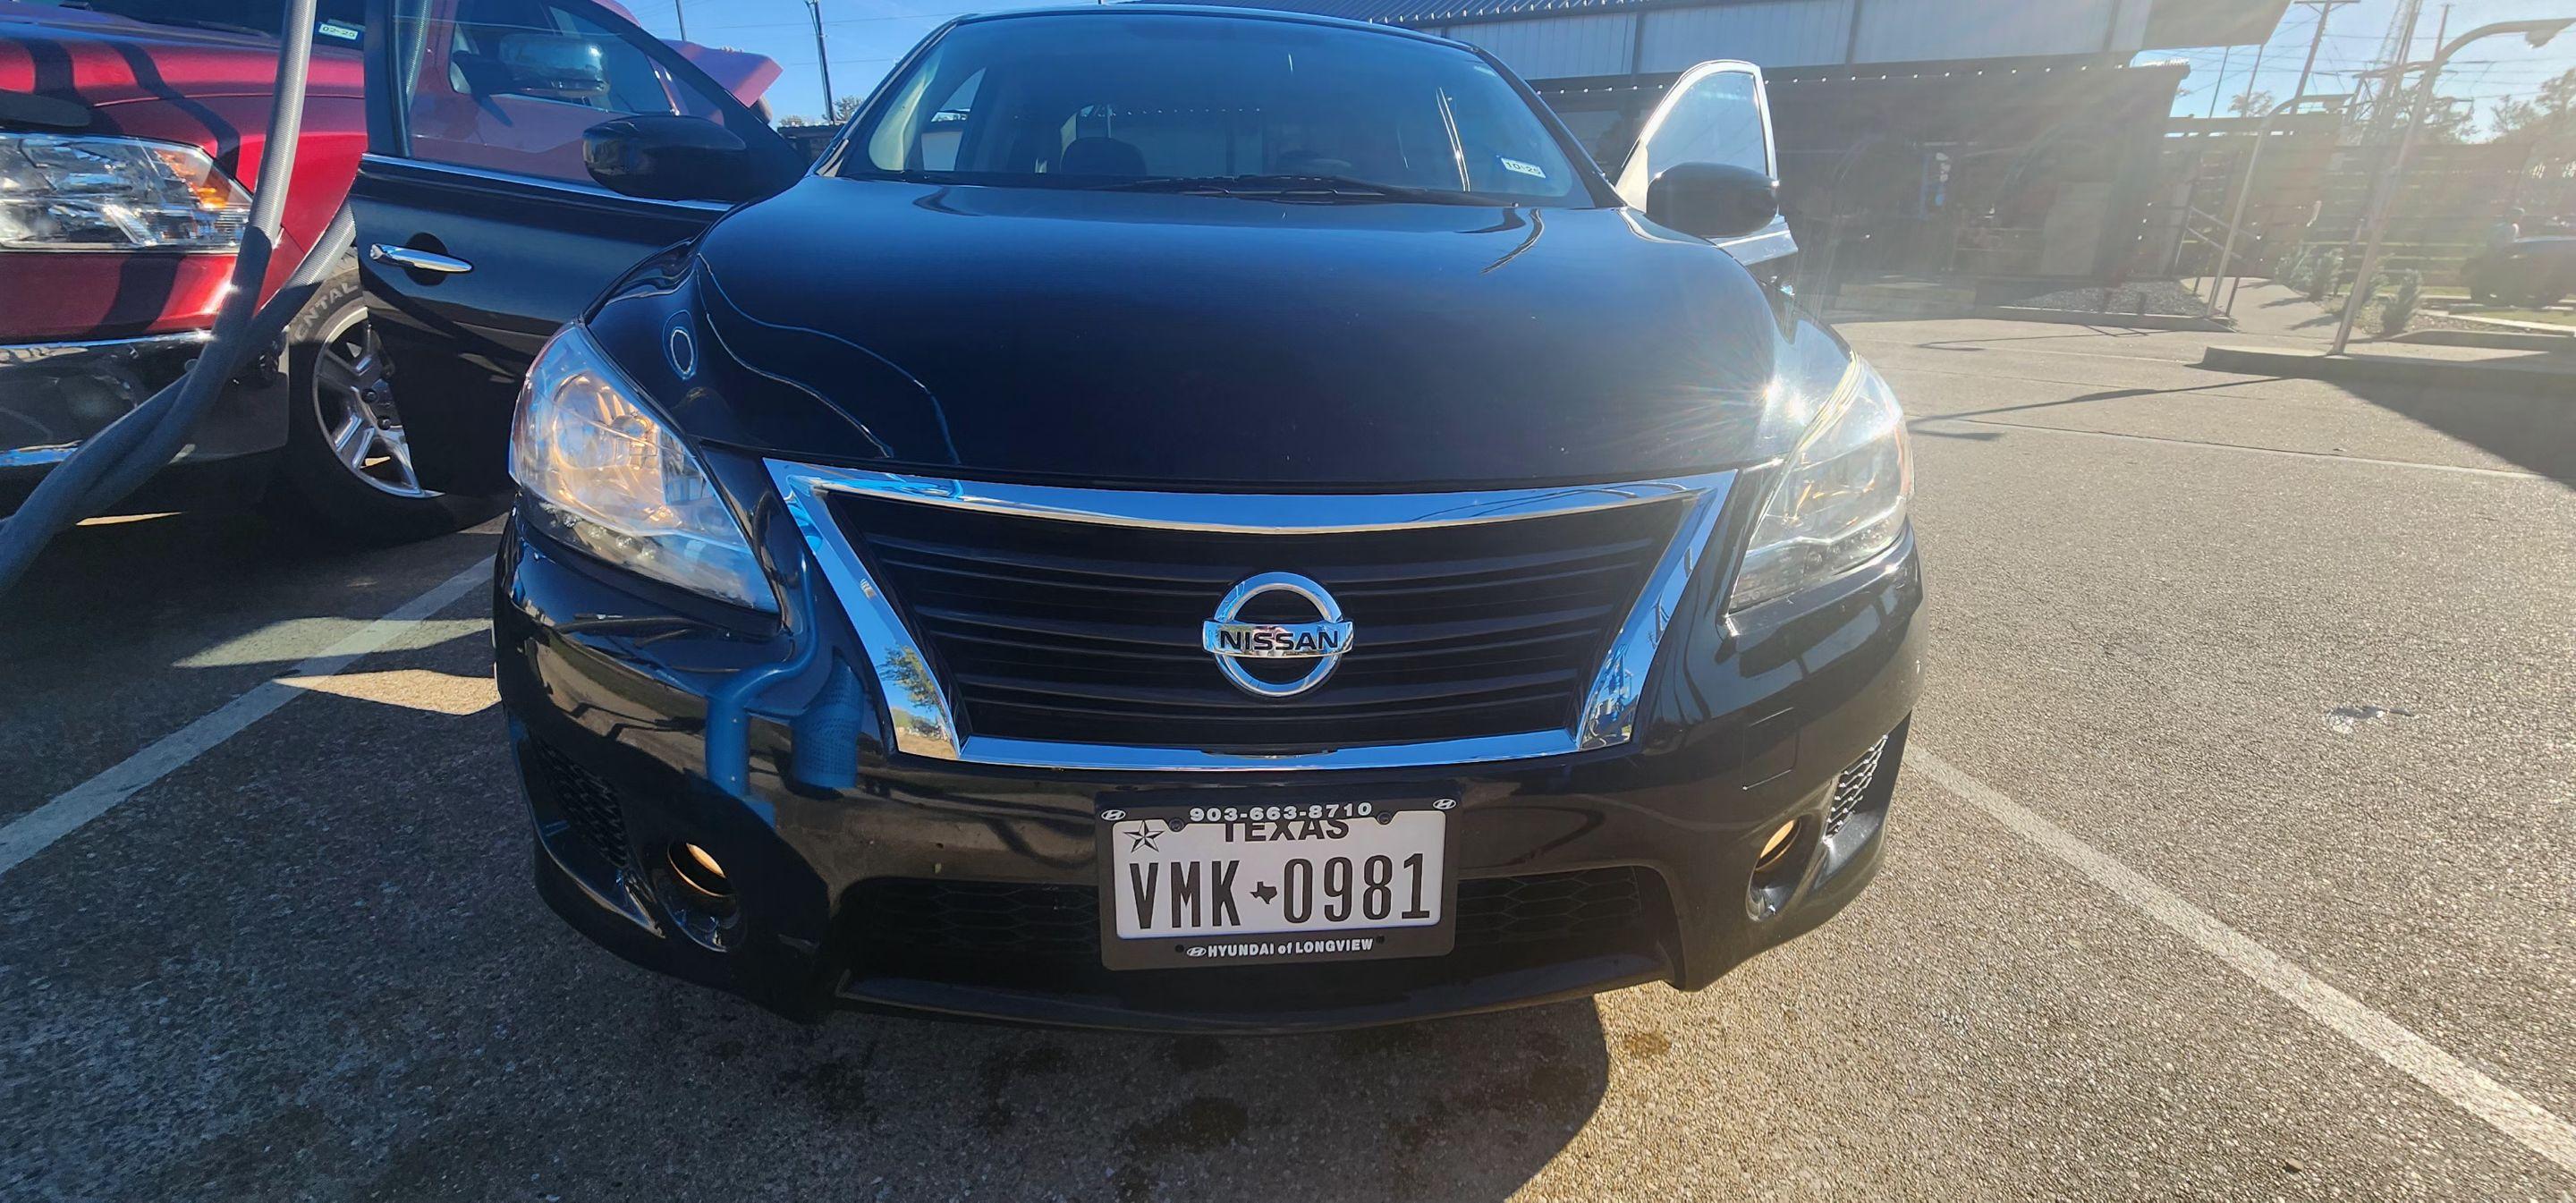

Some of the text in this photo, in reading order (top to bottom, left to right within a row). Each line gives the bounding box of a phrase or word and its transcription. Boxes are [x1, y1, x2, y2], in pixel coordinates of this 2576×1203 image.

[1220, 631, 1338, 650] NISSAN
[1190, 802, 1373, 822] 903-663-8710
[1224, 819, 1350, 843] TEXAS
[1130, 853, 1430, 929] VMK 0981
[1208, 938, 1374, 958] HYUNDAI of LONGVIEW
